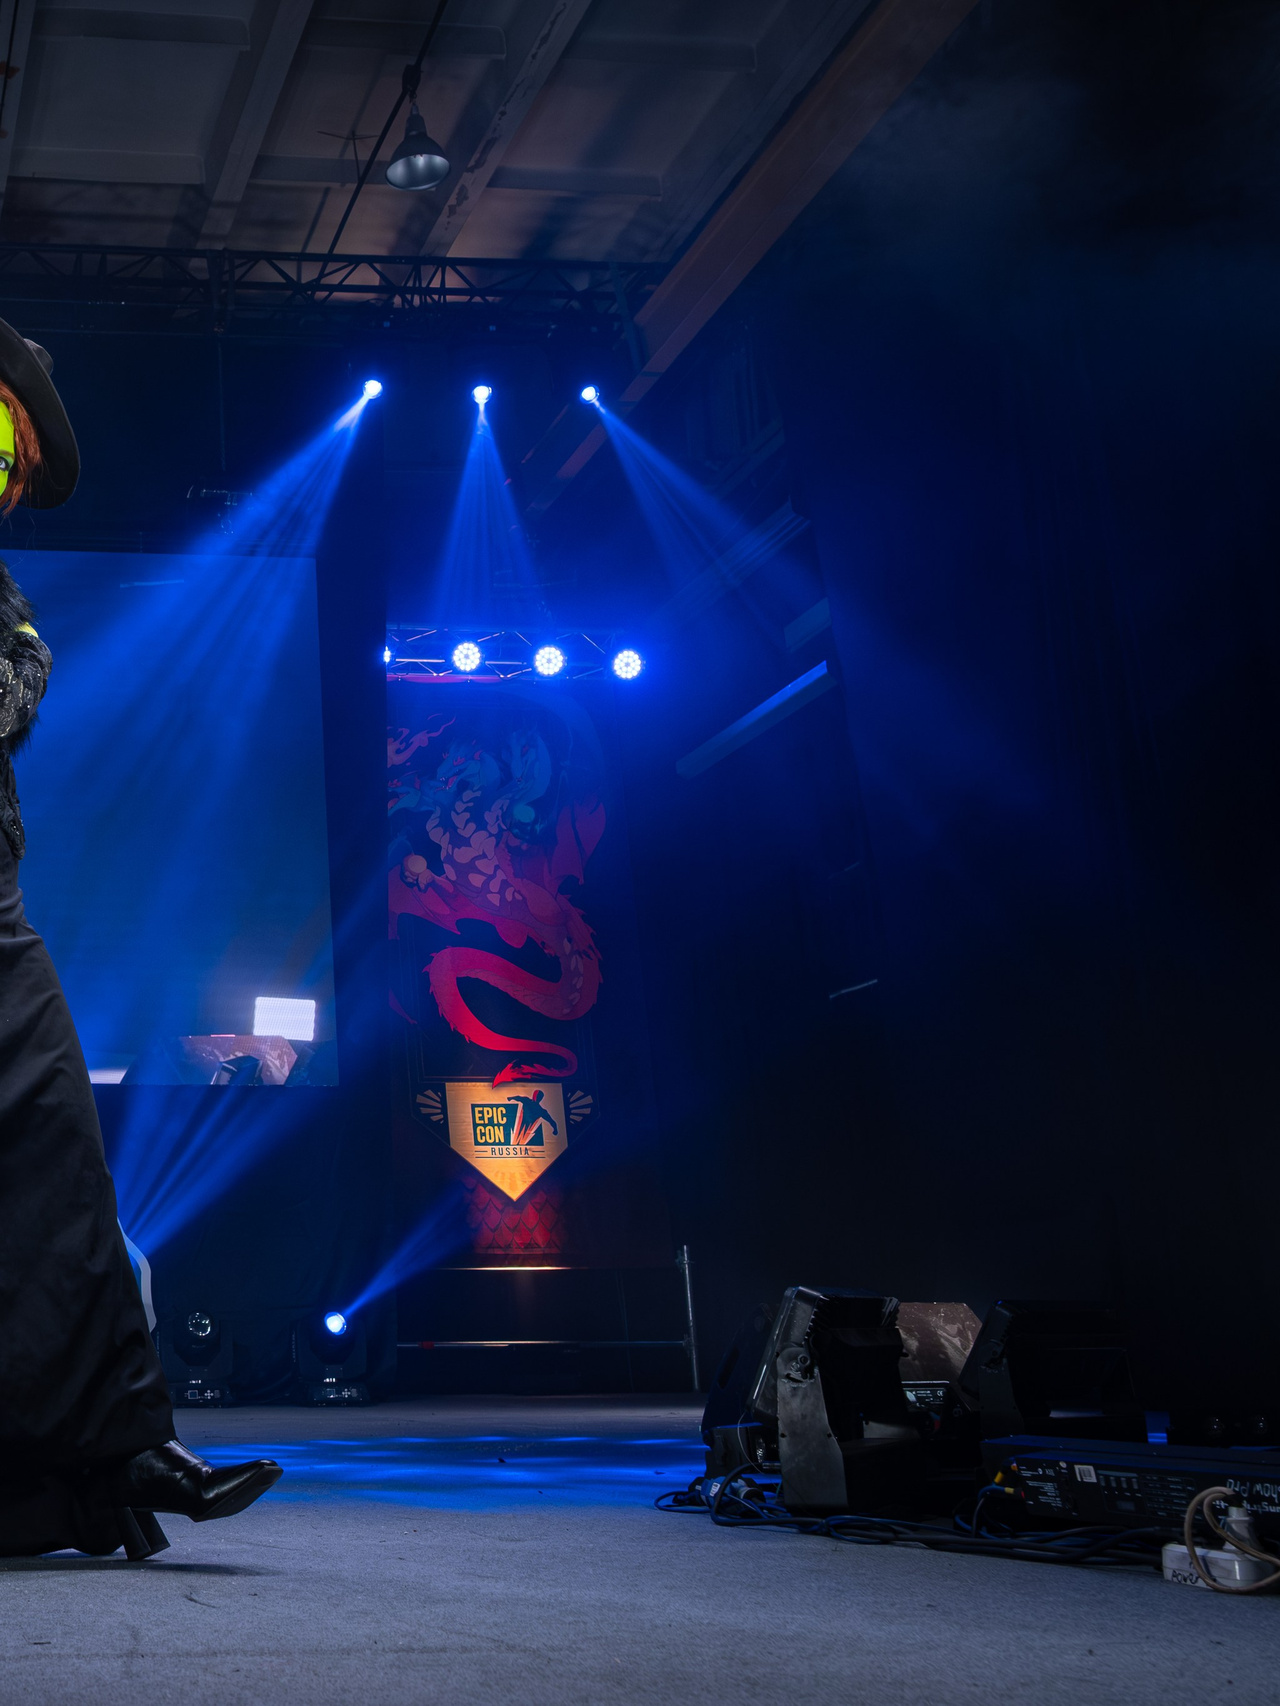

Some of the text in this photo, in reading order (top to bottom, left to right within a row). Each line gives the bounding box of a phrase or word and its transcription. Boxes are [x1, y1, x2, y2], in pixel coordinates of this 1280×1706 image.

[474, 1107, 507, 1125] EPIC
[476, 1125, 505, 1143] CON
[490, 1147, 530, 1156] RUSSIA
